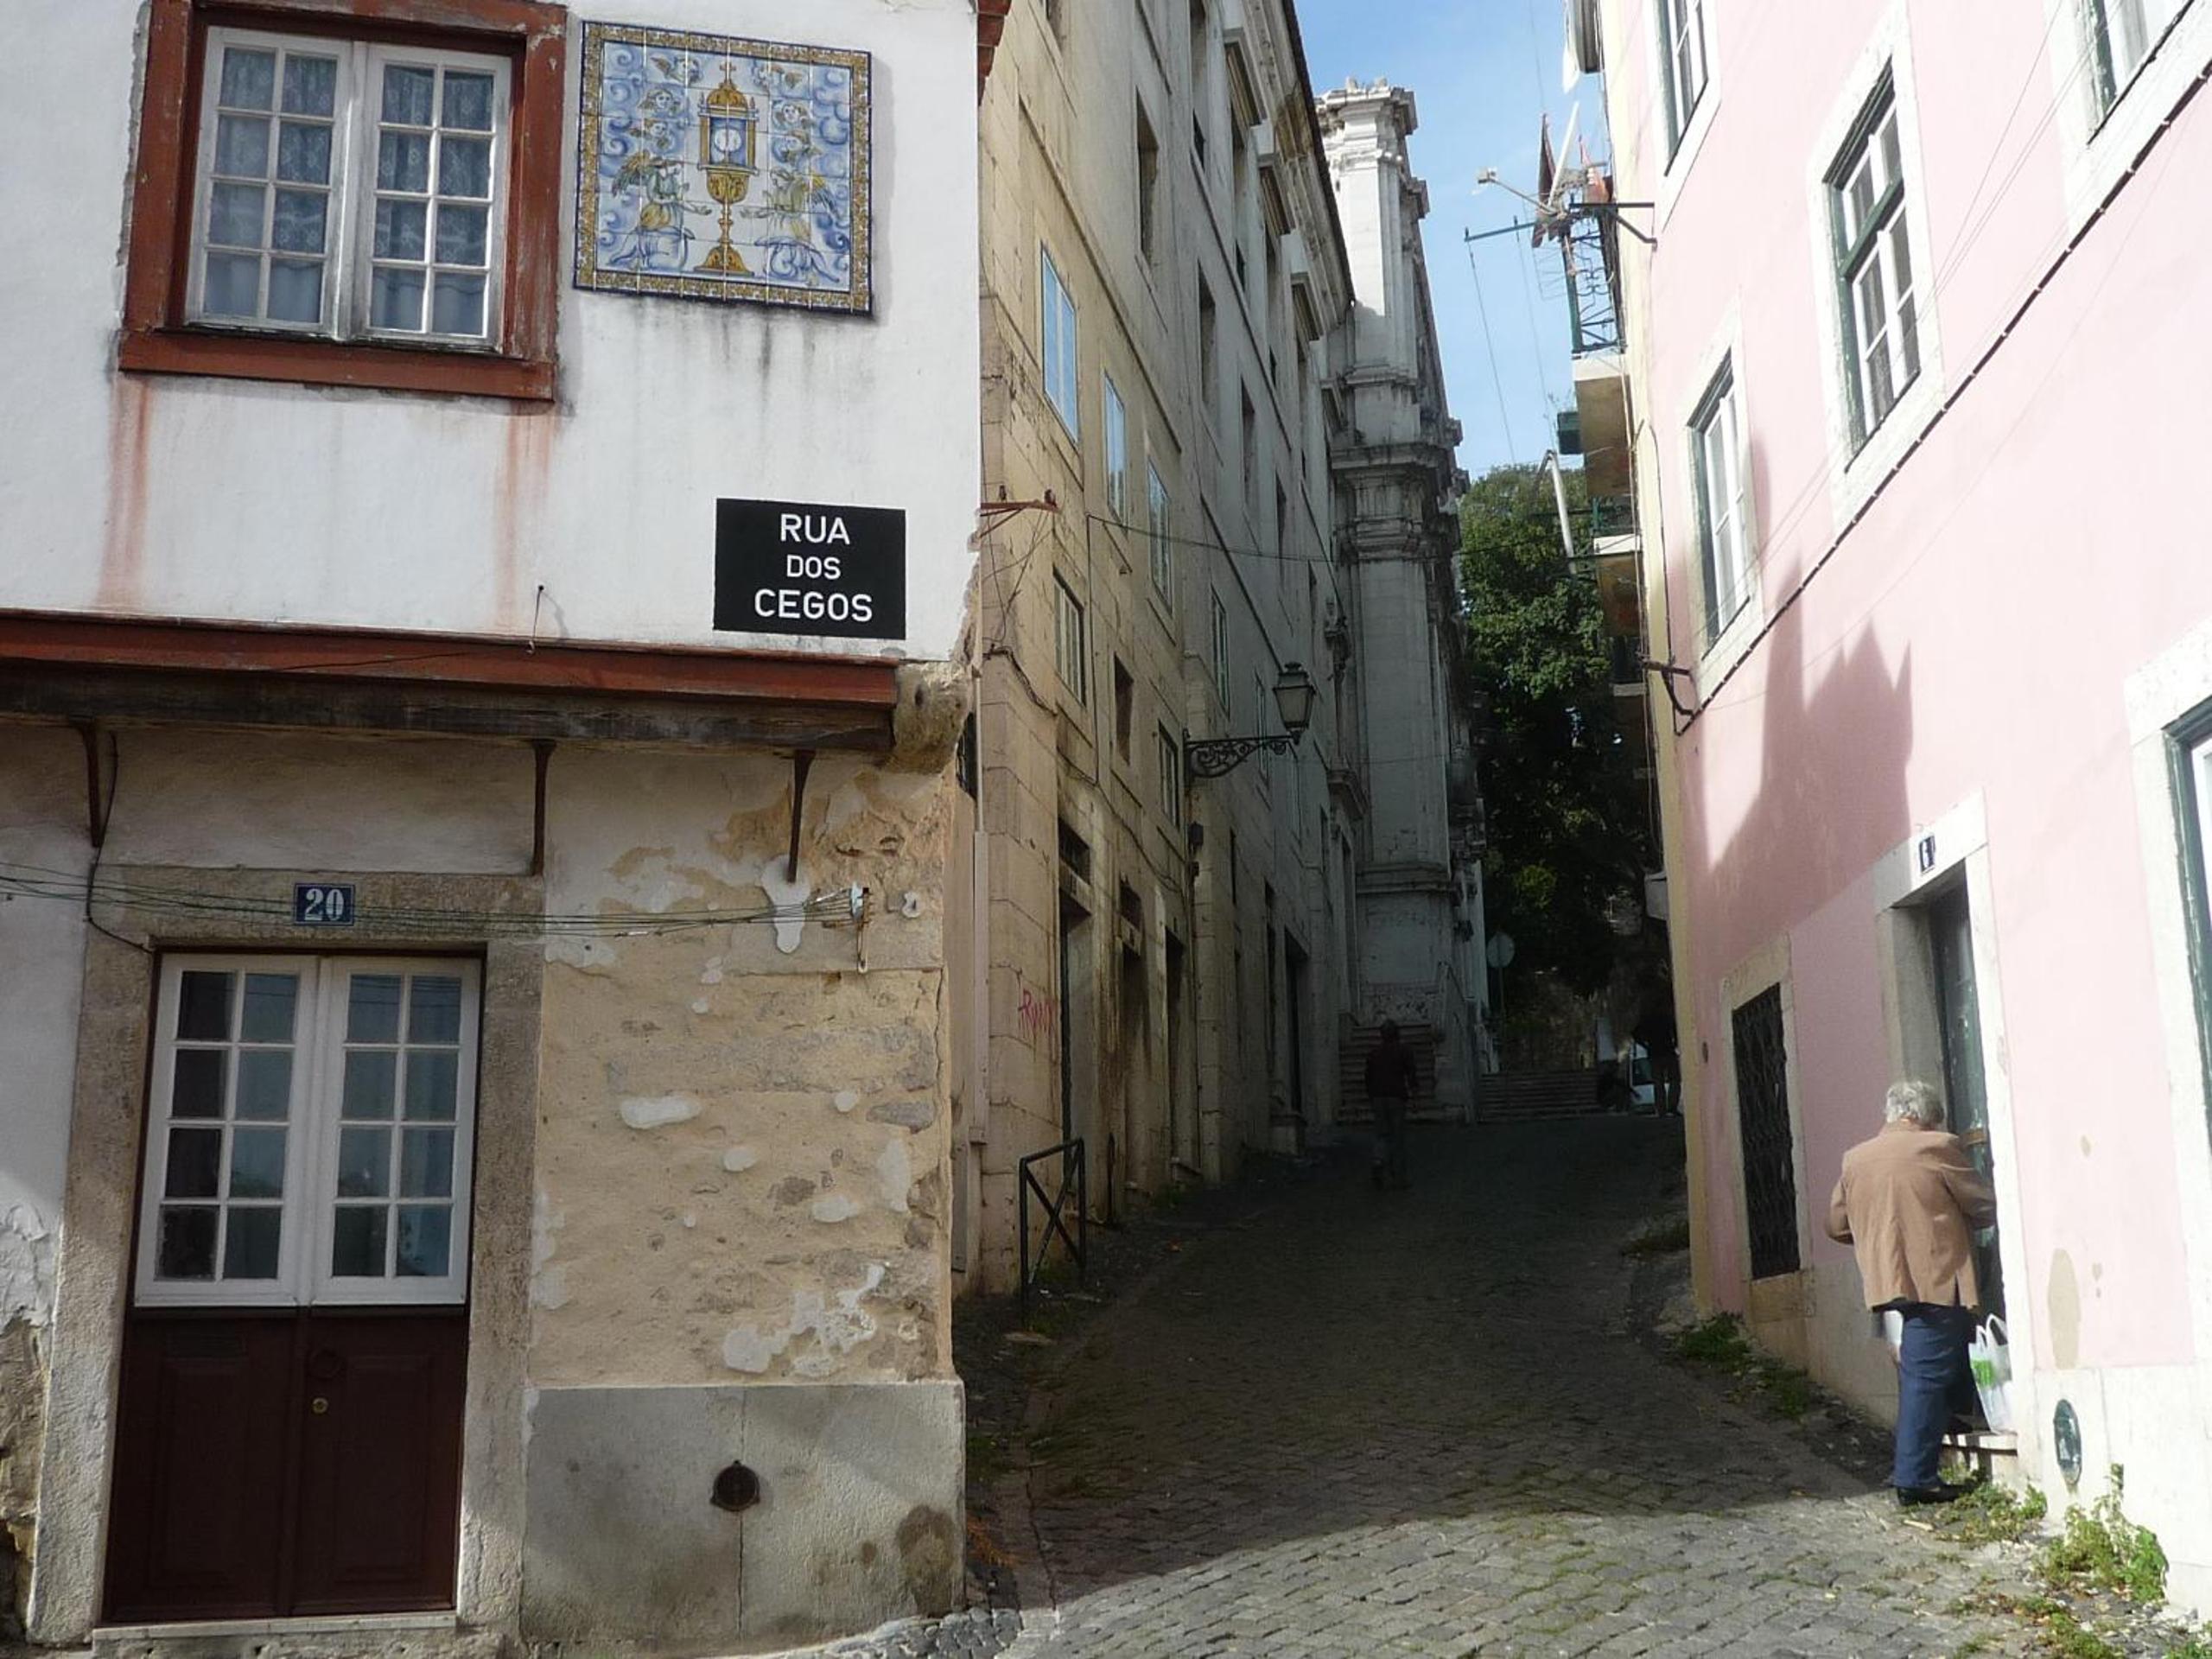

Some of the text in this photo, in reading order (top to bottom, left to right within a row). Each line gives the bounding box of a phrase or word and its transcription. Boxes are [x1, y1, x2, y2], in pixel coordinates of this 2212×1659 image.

[780, 513, 850, 544] RUA
[786, 555, 842, 580] DOS
[754, 588, 873, 622] CEGOS
[304, 888, 345, 921] 20
